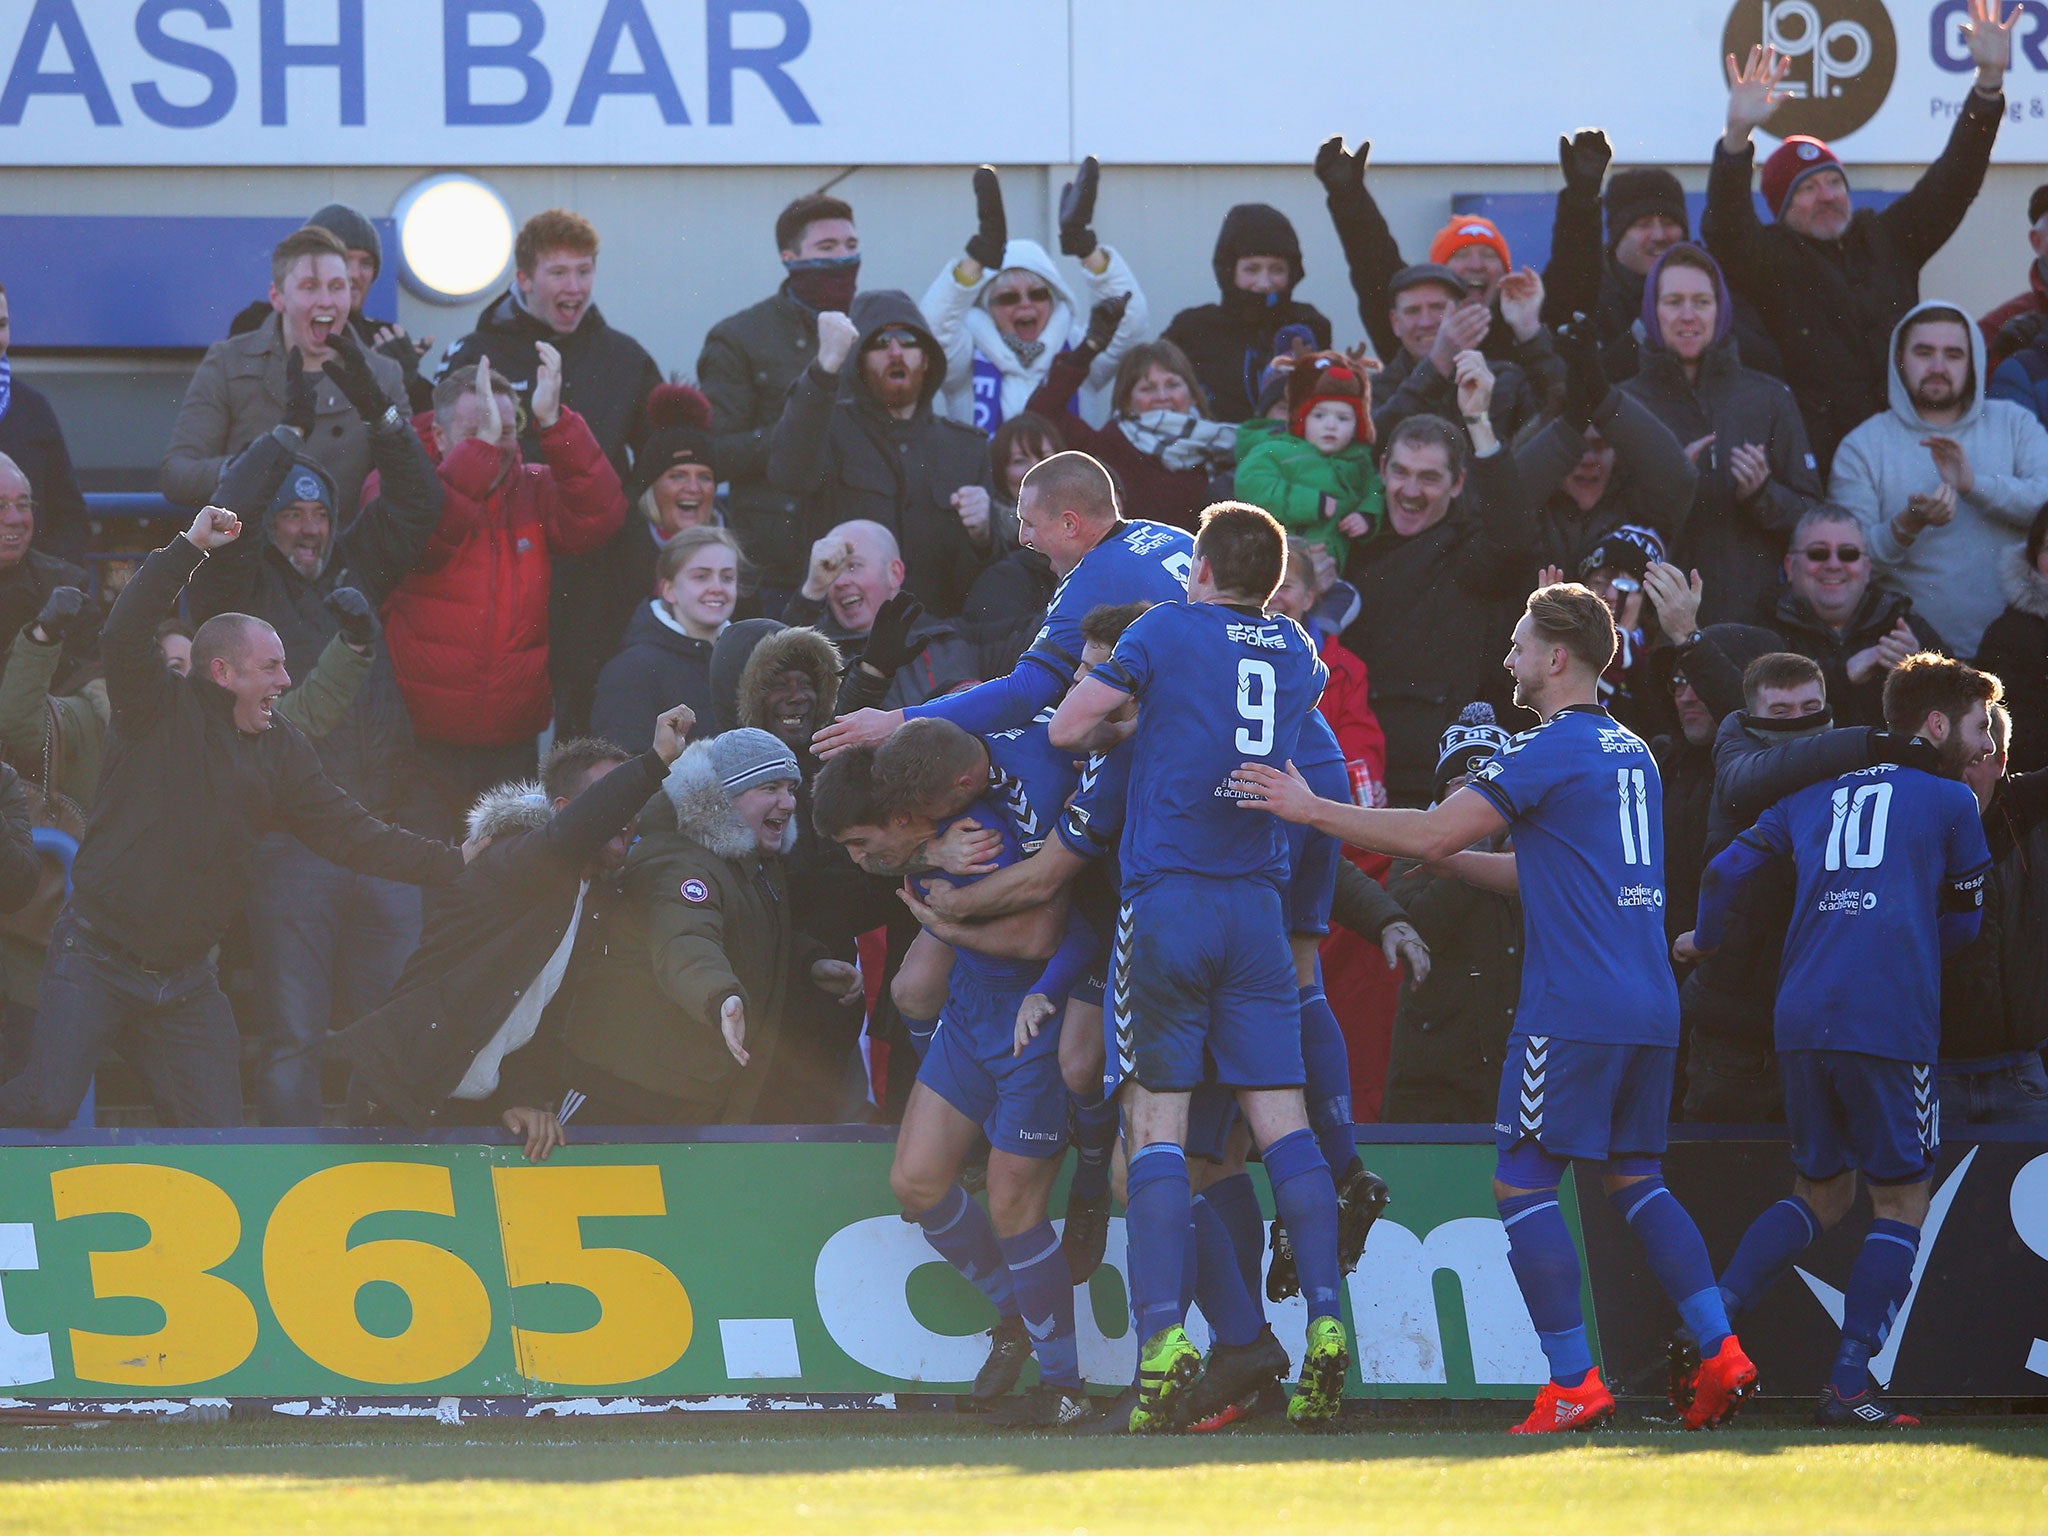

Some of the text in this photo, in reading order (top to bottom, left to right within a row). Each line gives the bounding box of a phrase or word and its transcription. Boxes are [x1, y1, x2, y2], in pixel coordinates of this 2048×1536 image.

[0, 0, 821, 128] ASH BAR
[1227, 630, 1287, 649] SPORTS
[1236, 658, 1277, 756] 9
[1601, 742, 1644, 753] SPORTS
[1618, 768, 1651, 865] 11
[1825, 782, 1893, 871] 10
